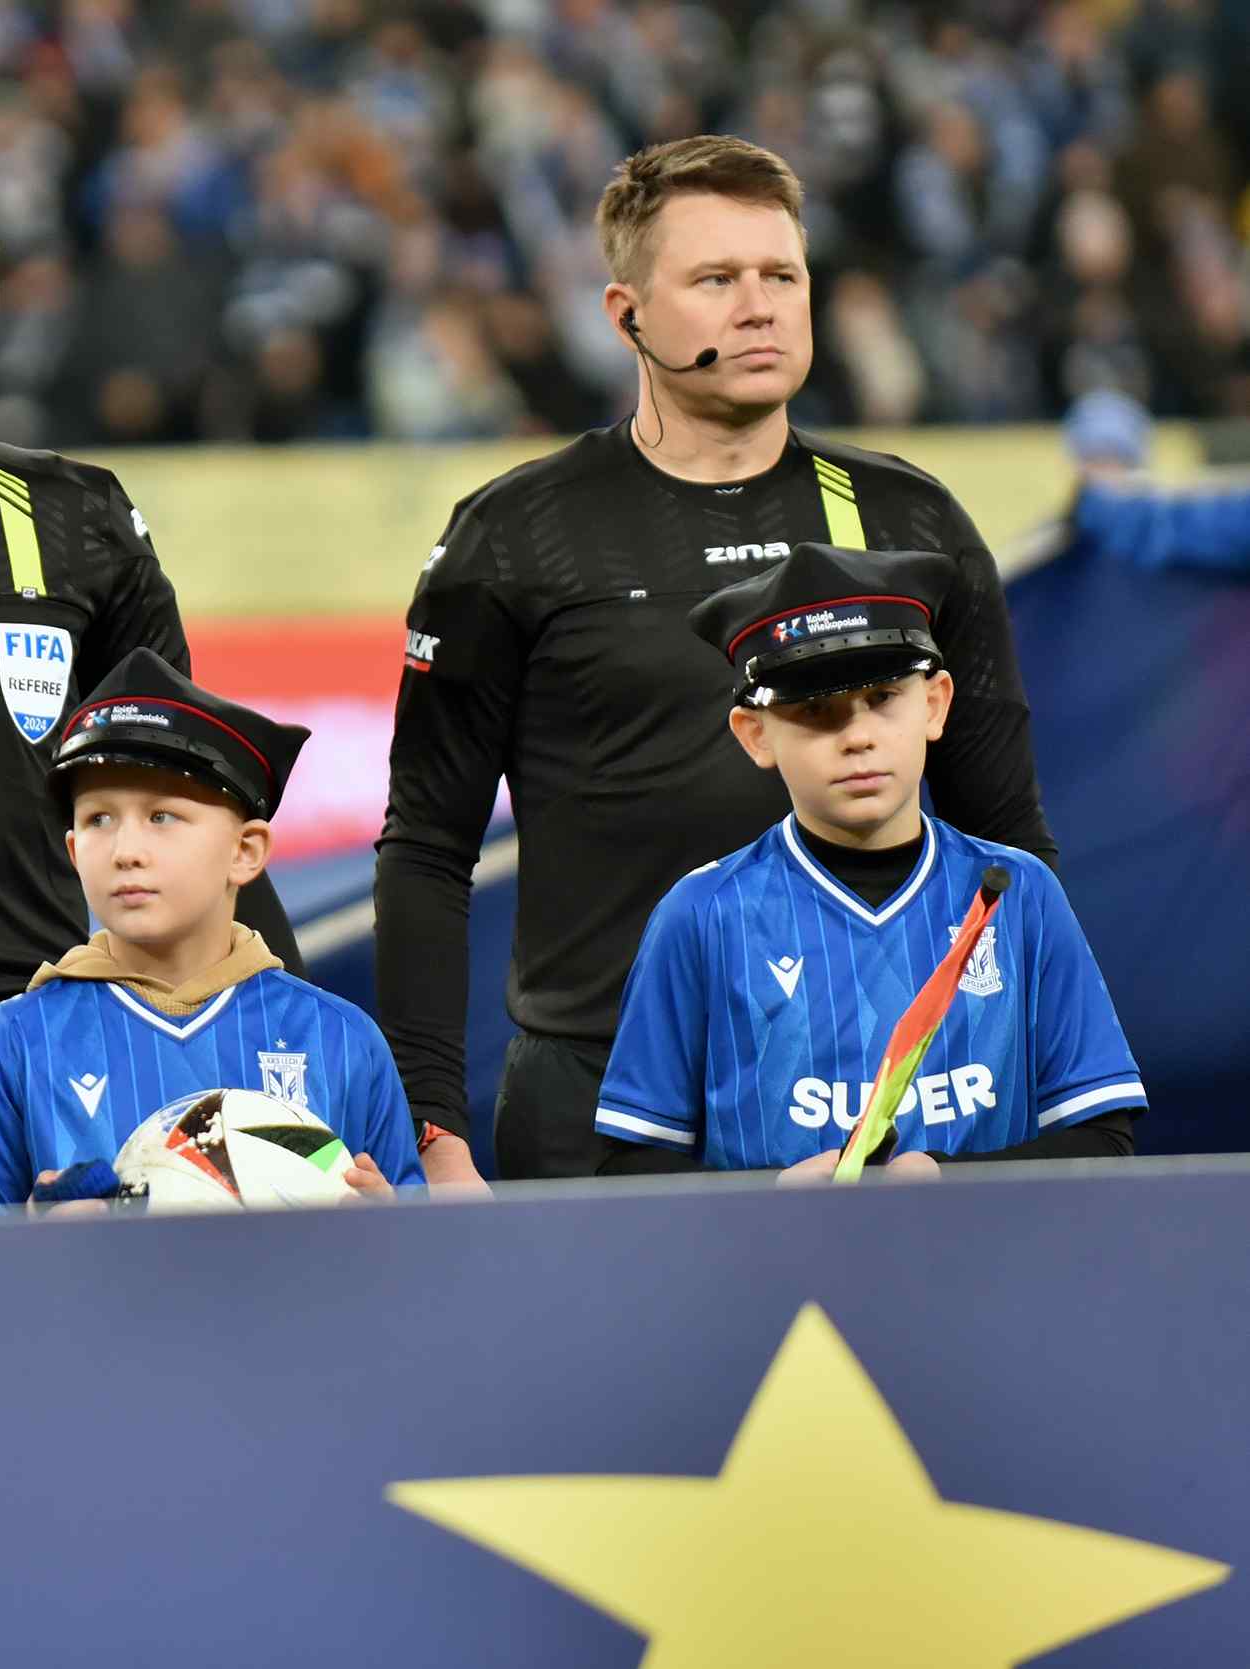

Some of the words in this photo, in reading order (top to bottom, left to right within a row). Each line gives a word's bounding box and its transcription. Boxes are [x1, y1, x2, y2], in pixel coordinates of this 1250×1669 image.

[704, 541, 791, 564] zina
[805, 610, 834, 626] Koleje
[5, 631, 66, 663] FIFA
[8, 676, 62, 696] REFEREE
[22, 715, 47, 731] 2024
